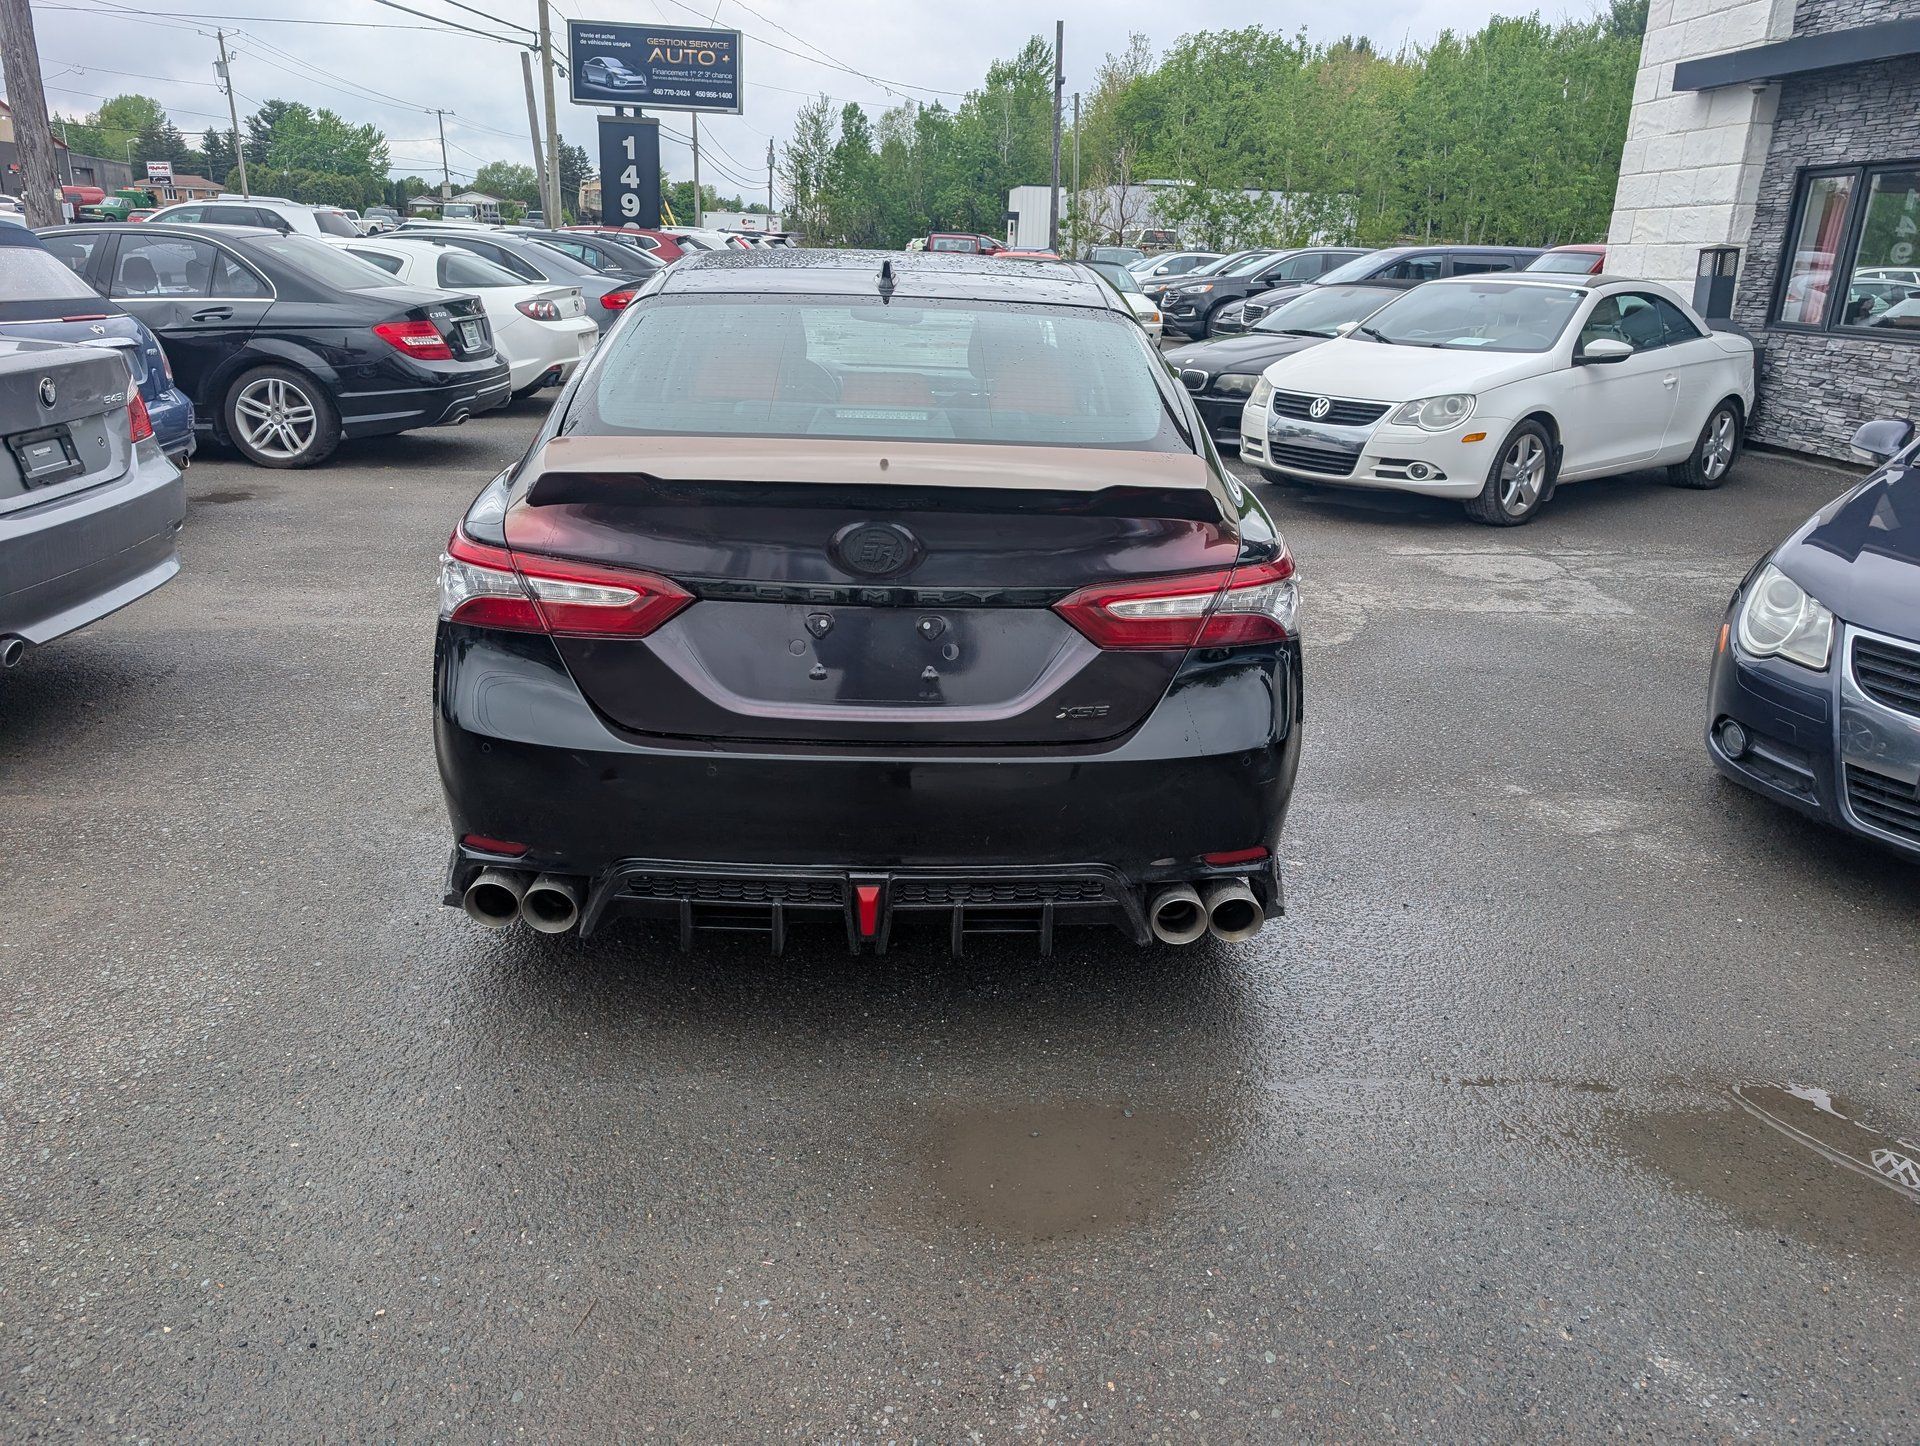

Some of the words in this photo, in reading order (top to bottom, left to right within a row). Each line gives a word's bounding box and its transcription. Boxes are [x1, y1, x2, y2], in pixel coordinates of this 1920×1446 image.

[646, 37, 687, 47] GESTION
[689, 40, 729, 50] SERVICE
[647, 48, 716, 65] AUTO
[652, 68, 688, 76] Financement
[756, 586, 1004, 603] CAMRY
[1056, 706, 1110, 718] XSE
